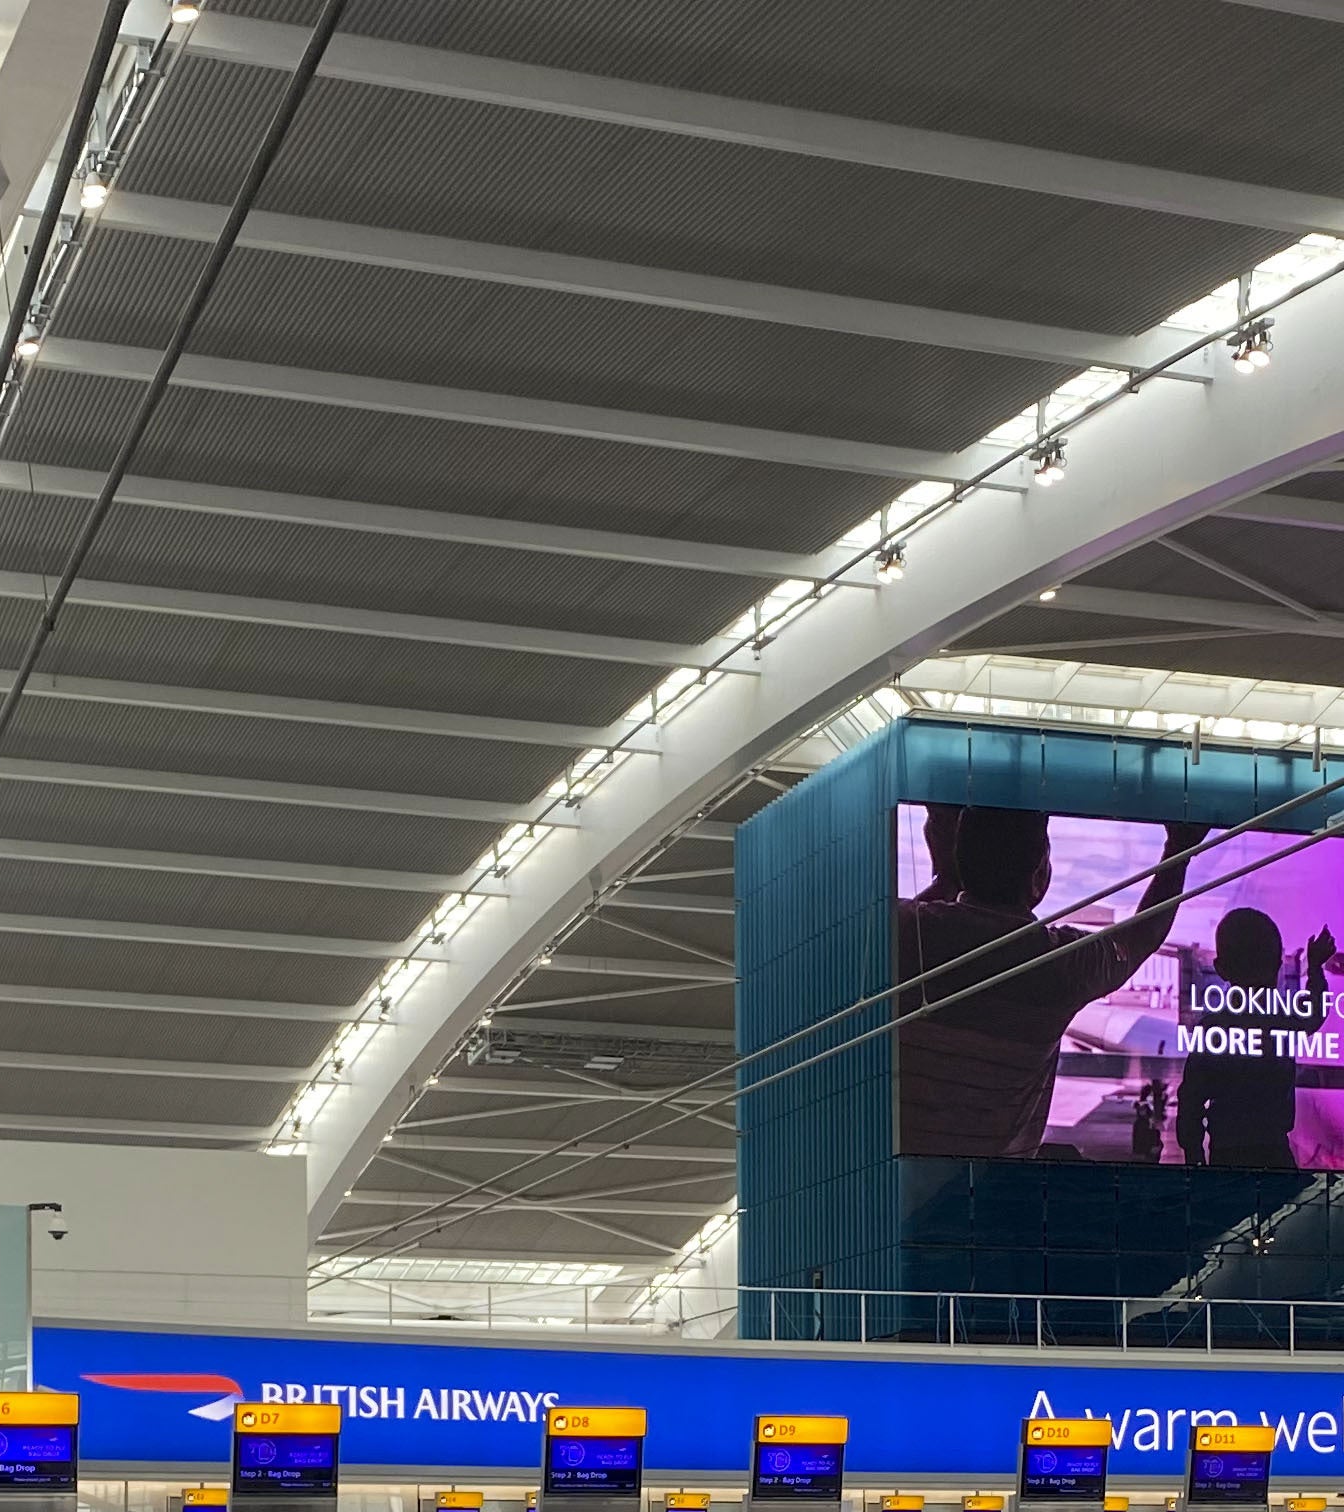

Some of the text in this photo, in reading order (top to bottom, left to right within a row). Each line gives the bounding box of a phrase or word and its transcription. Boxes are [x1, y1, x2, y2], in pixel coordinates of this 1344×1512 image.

[1190, 983, 1312, 1017] LOOKING
[1177, 1024, 1263, 1056] MORE
[1270, 1029, 1340, 1059] TIME
[261, 1383, 405, 1419] BRITISH
[260, 1413, 280, 1424] D7
[572, 1416, 589, 1428] D8
[779, 1425, 796, 1435] D9
[1047, 1428, 1069, 1438] D10
[1215, 1434, 1235, 1444] D11
[0, 1464, 14, 1473] Bag
[16, 1464, 35, 1473] Drop
